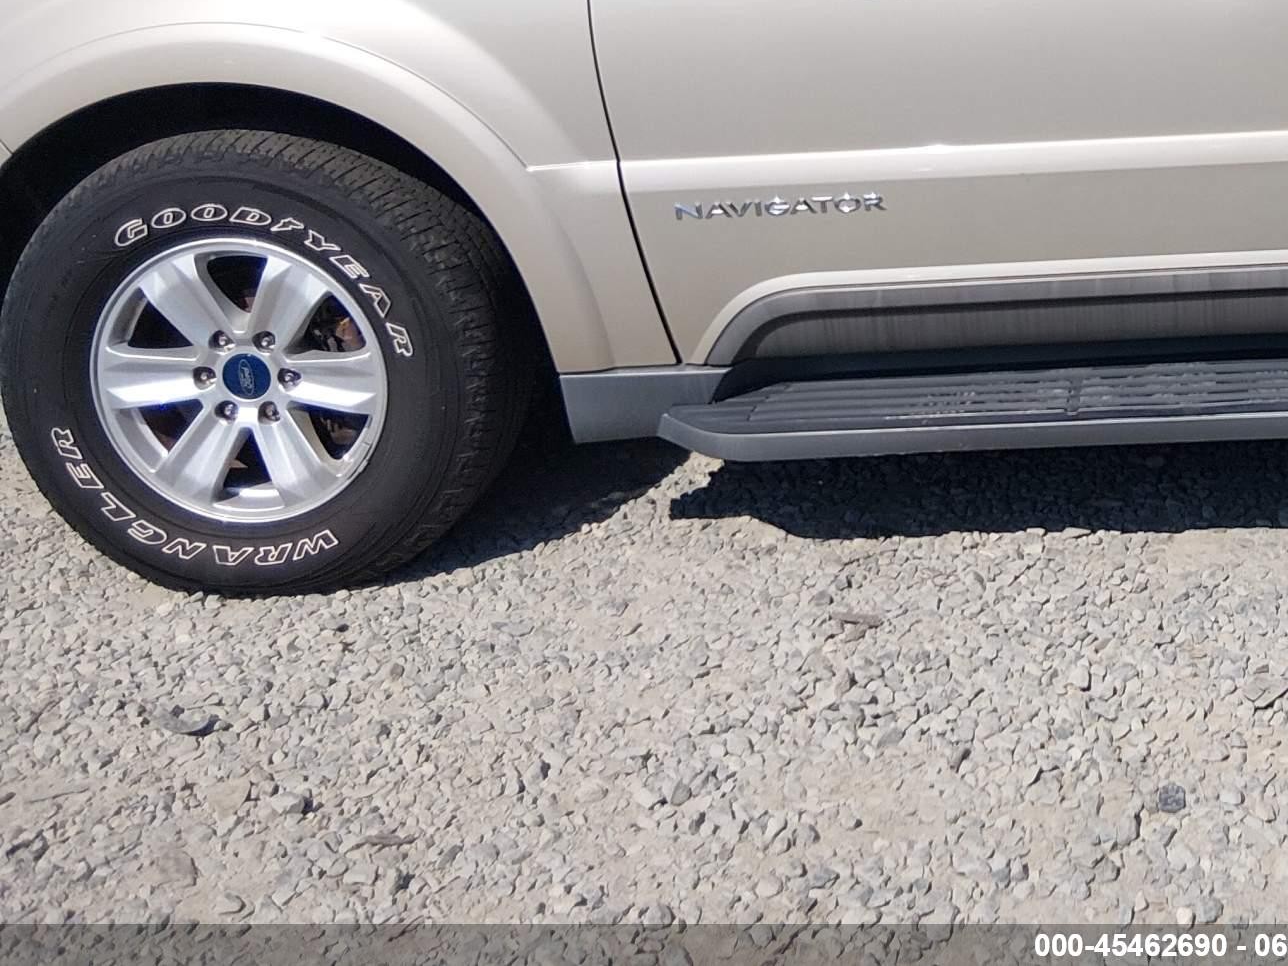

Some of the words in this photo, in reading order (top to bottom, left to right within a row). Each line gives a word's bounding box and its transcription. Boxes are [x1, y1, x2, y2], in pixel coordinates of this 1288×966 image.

[674, 192, 887, 220] NAVIGATOR
[113, 203, 414, 358] GOODYEAR
[50, 426, 340, 567] WRANGLER
